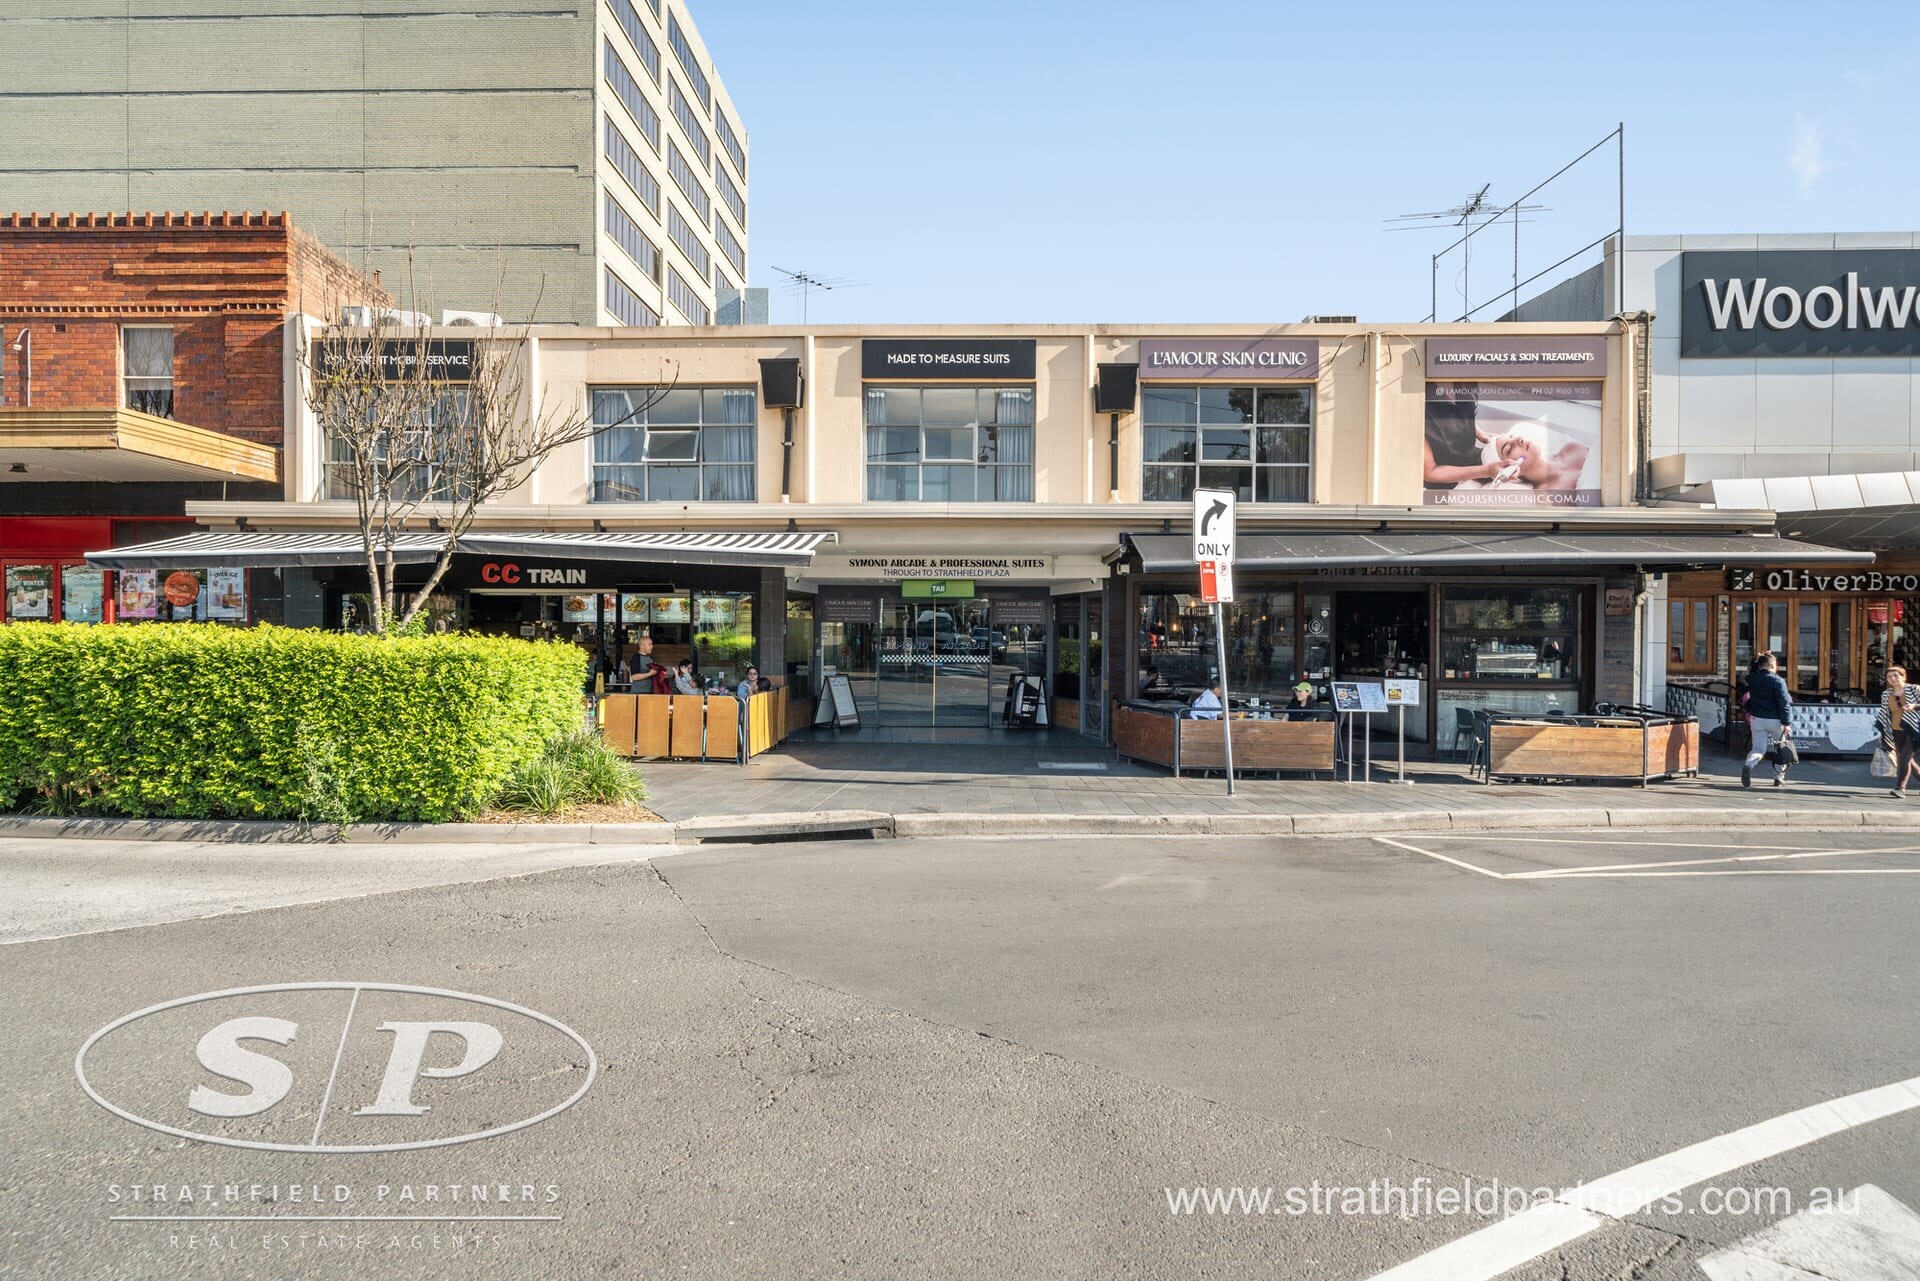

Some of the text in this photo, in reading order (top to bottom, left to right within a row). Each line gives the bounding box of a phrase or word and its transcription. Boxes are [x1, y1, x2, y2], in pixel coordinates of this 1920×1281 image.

[1703, 271, 1920, 330] Woolw
[427, 355, 468, 365] SERVICE
[887, 353, 1010, 364] MADE TO MEASURE SUITS
[1153, 351, 1307, 366] L'AMOUR SKIN CLINIC
[1439, 352, 1594, 362] LUXURY FACIALS & SKIN TREATMENTS
[1531, 387, 1542, 395] PH
[1543, 387, 1553, 395] 02
[1555, 387, 1573, 395] 9160
[1574, 387, 1590, 395] 9150
[1434, 494, 1590, 504] LAMOURSKINCLINIC.COM.AU
[1197, 542, 1231, 557] ONLY
[848, 559, 1045, 568] SYMOND ARCADE & PROFESSIONAL SUITES
[481, 563, 586, 584] CC TRAIN
[883, 569, 1010, 577] THROUGH TO STRATHFIELD PLAZA
[942, 640, 987, 650] ARCADE
